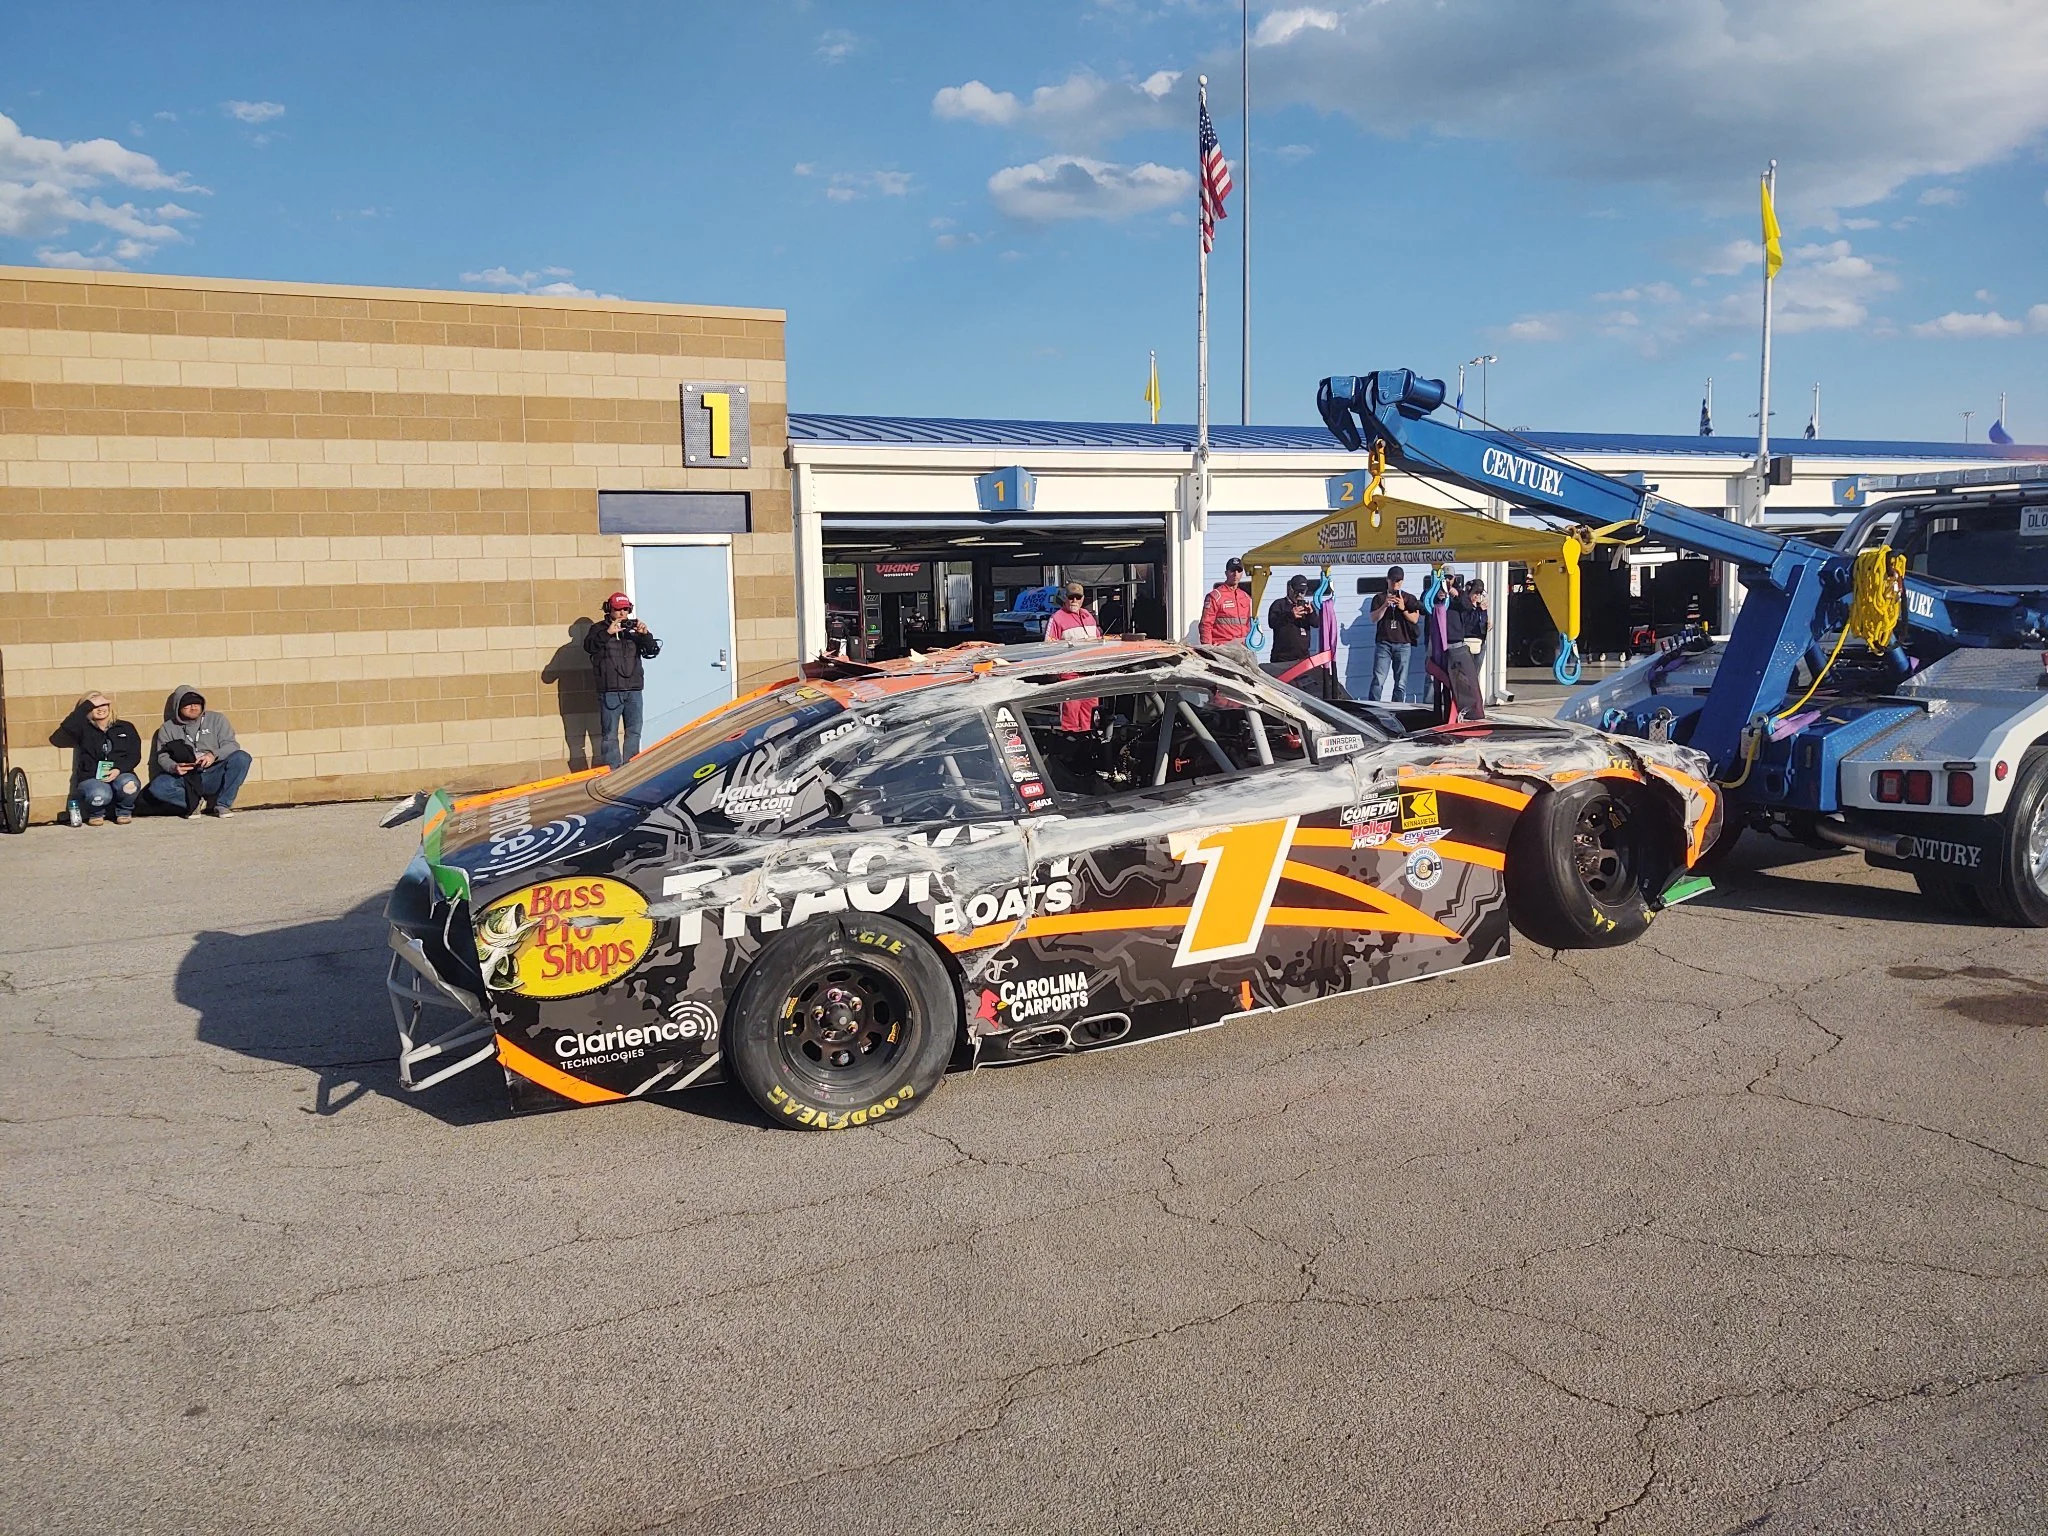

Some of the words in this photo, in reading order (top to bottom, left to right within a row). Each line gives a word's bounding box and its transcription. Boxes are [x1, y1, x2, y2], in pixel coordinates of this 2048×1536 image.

[702, 392, 731, 457] 1
[993, 480, 1005, 502] 1
[1023, 481, 1030, 502] 1
[1340, 482, 1354, 501] 2
[1843, 485, 1856, 501] 4
[875, 562, 921, 574] VIKING
[1303, 554, 1321, 565] SLOW
[1346, 553, 1366, 564] MOVE
[1366, 553, 1386, 564] OVER
[1386, 553, 1401, 563] FOR
[1403, 552, 1420, 563] TOW
[1421, 551, 1454, 562] TRUCKS
[994, 721, 1019, 729] AXALTA
[1324, 745, 1343, 754] RACE
[1344, 743, 1358, 751] CAR
[1023, 785, 1041, 795] SEM
[724, 795, 795, 815] Cars.com
[1343, 798, 1398, 822] COMETIC
[1351, 820, 1392, 840] Holley
[1403, 817, 1438, 829] KENNAMETAL
[1351, 833, 1388, 851] MSD
[1404, 831, 1421, 841] FIVE
[1409, 849, 1437, 865] CHAMPION
[1911, 836, 1982, 868] NTURY
[528, 883, 606, 918] Bass
[1167, 815, 1300, 968] 1
[934, 880, 1074, 936] BOATS
[541, 939, 636, 979] Shops
[999, 971, 1089, 1006] CAROLINA
[1010, 990, 1089, 1022] CARPORTS
[555, 1018, 698, 1058] Clarience
[560, 1048, 645, 1071] TECHNOLOGIES
